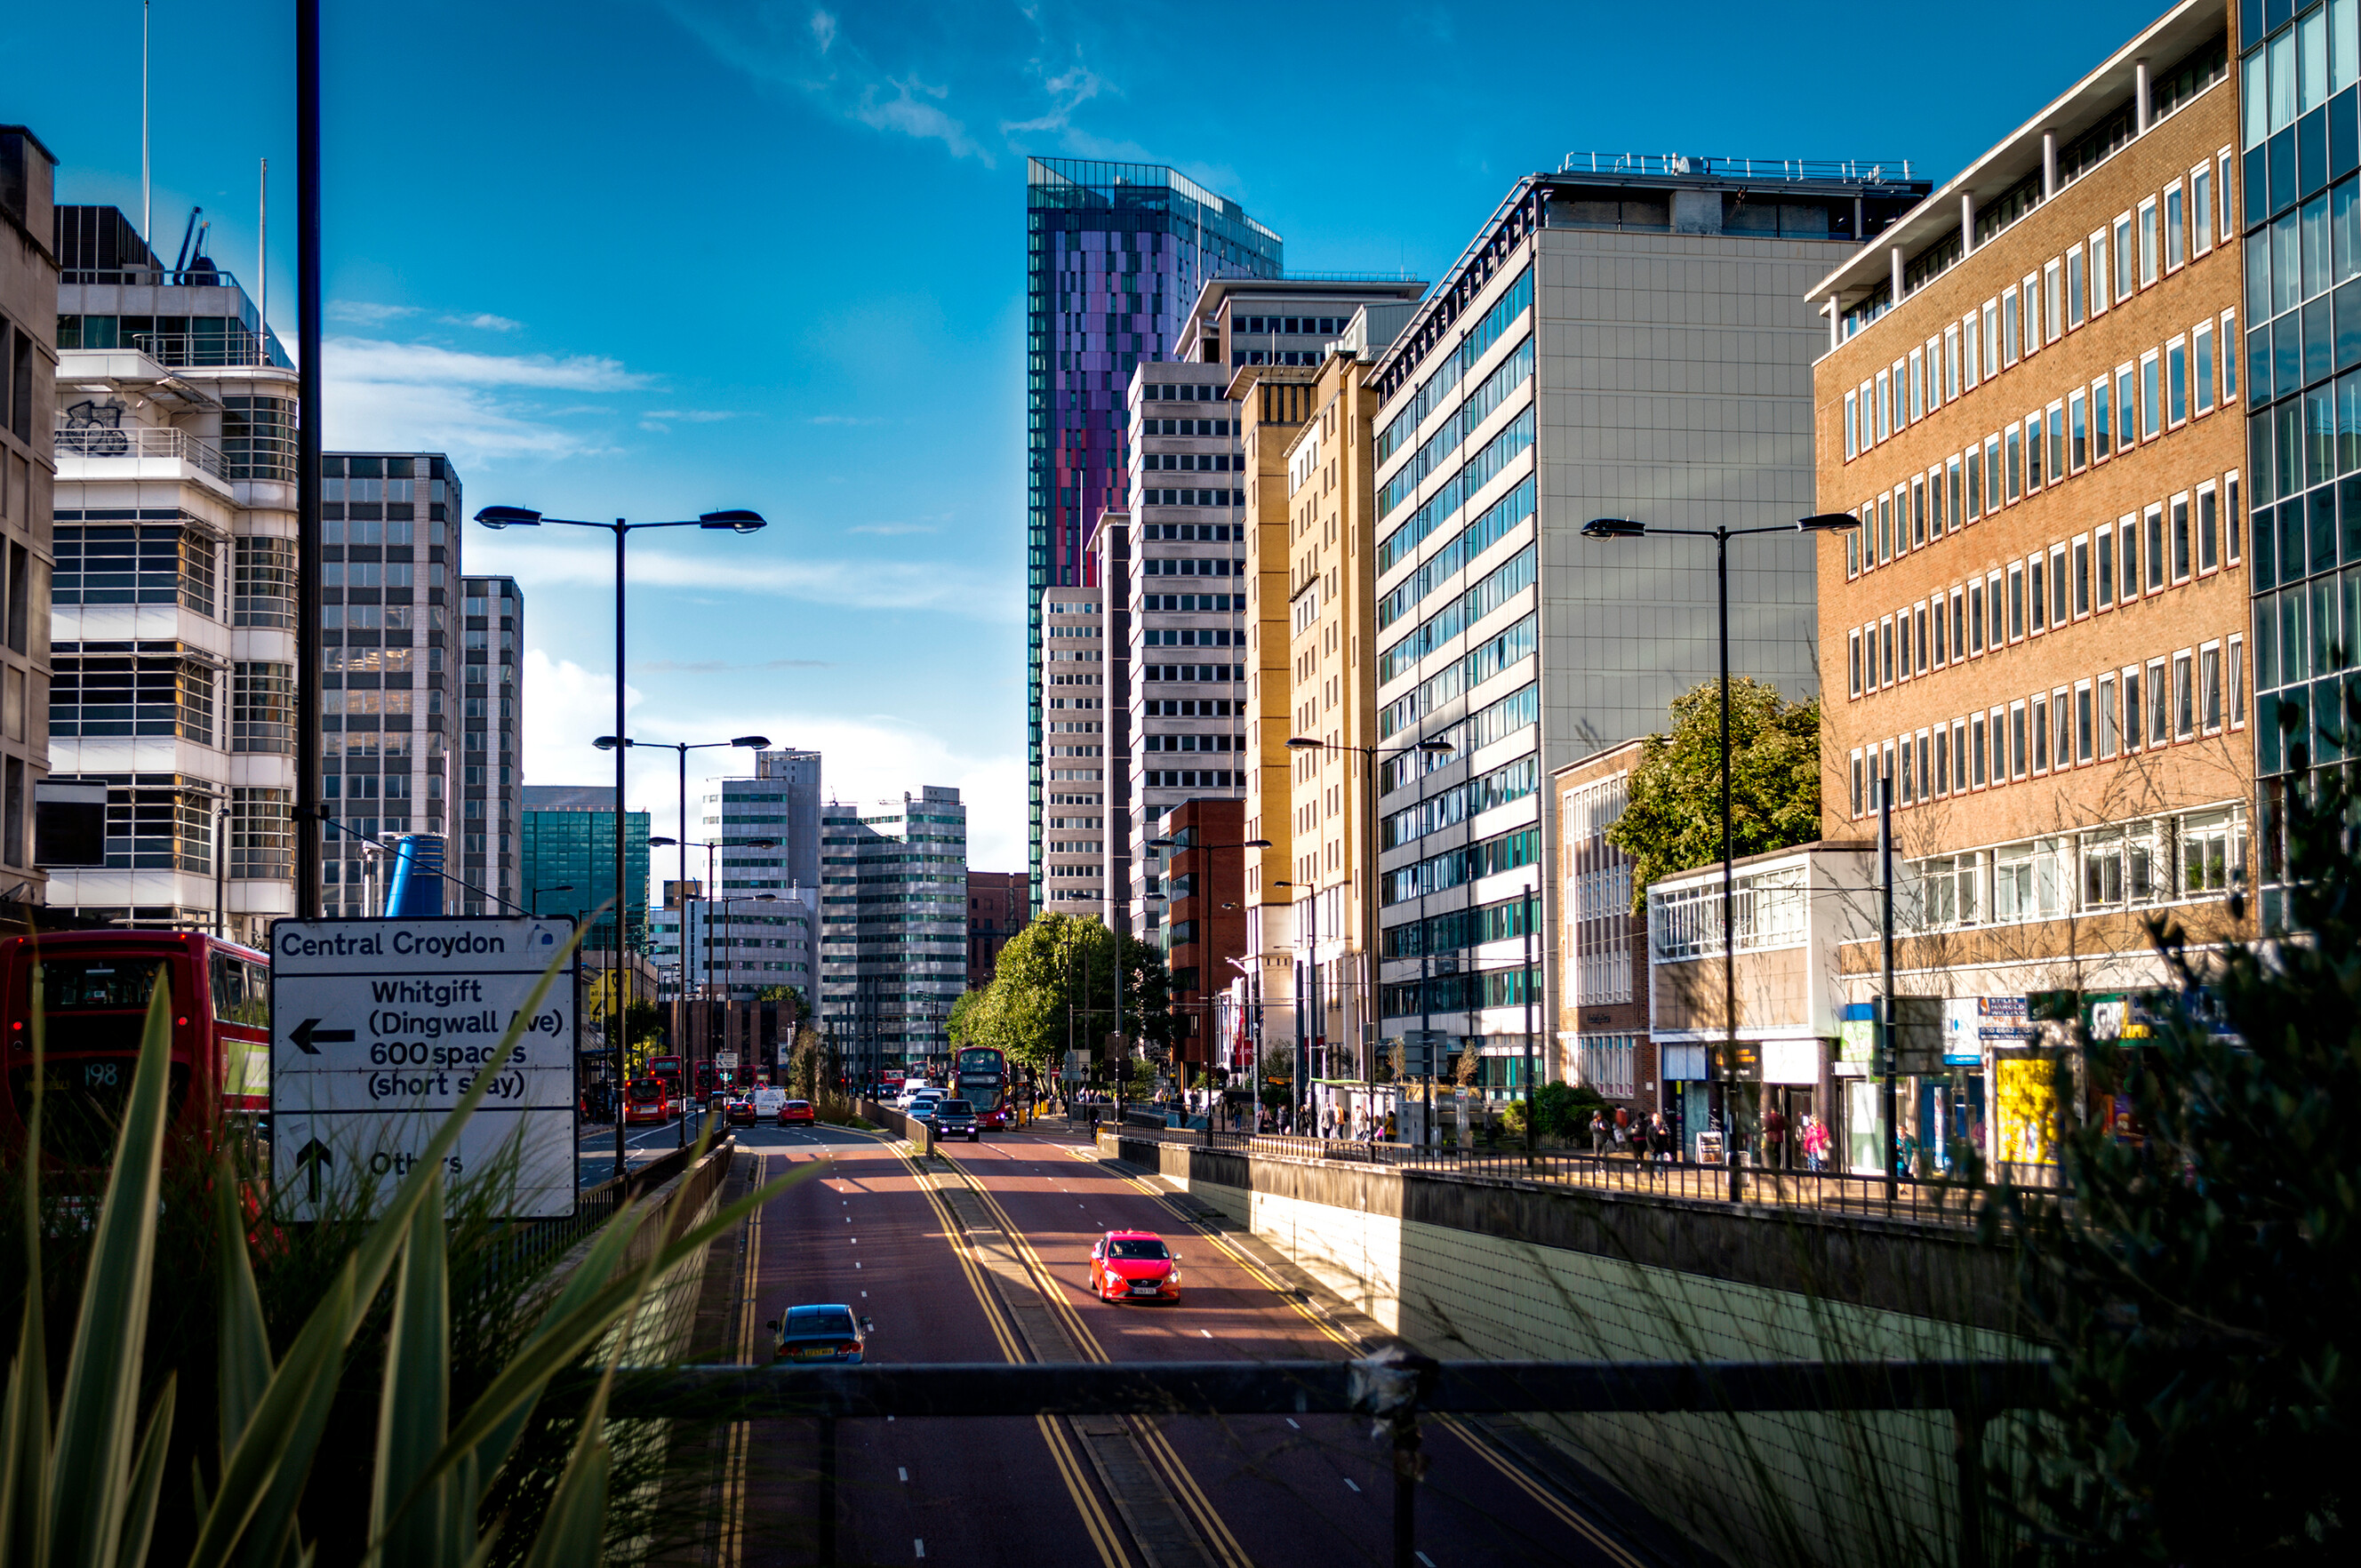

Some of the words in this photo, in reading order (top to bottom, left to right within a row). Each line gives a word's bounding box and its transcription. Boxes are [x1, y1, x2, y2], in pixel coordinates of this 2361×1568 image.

[281, 932, 383, 956] Central
[393, 932, 505, 958] Croydon
[372, 980, 483, 1007] Whitgift
[369, 1009, 499, 1038] (Dingwall
[370, 1042, 428, 1065] 600
[433, 1044, 527, 1069] spacs
[84, 1062, 118, 1087] 198
[368, 1070, 448, 1101] (short
[458, 1069, 525, 1100] say)
[370, 1151, 464, 1175] Oths
